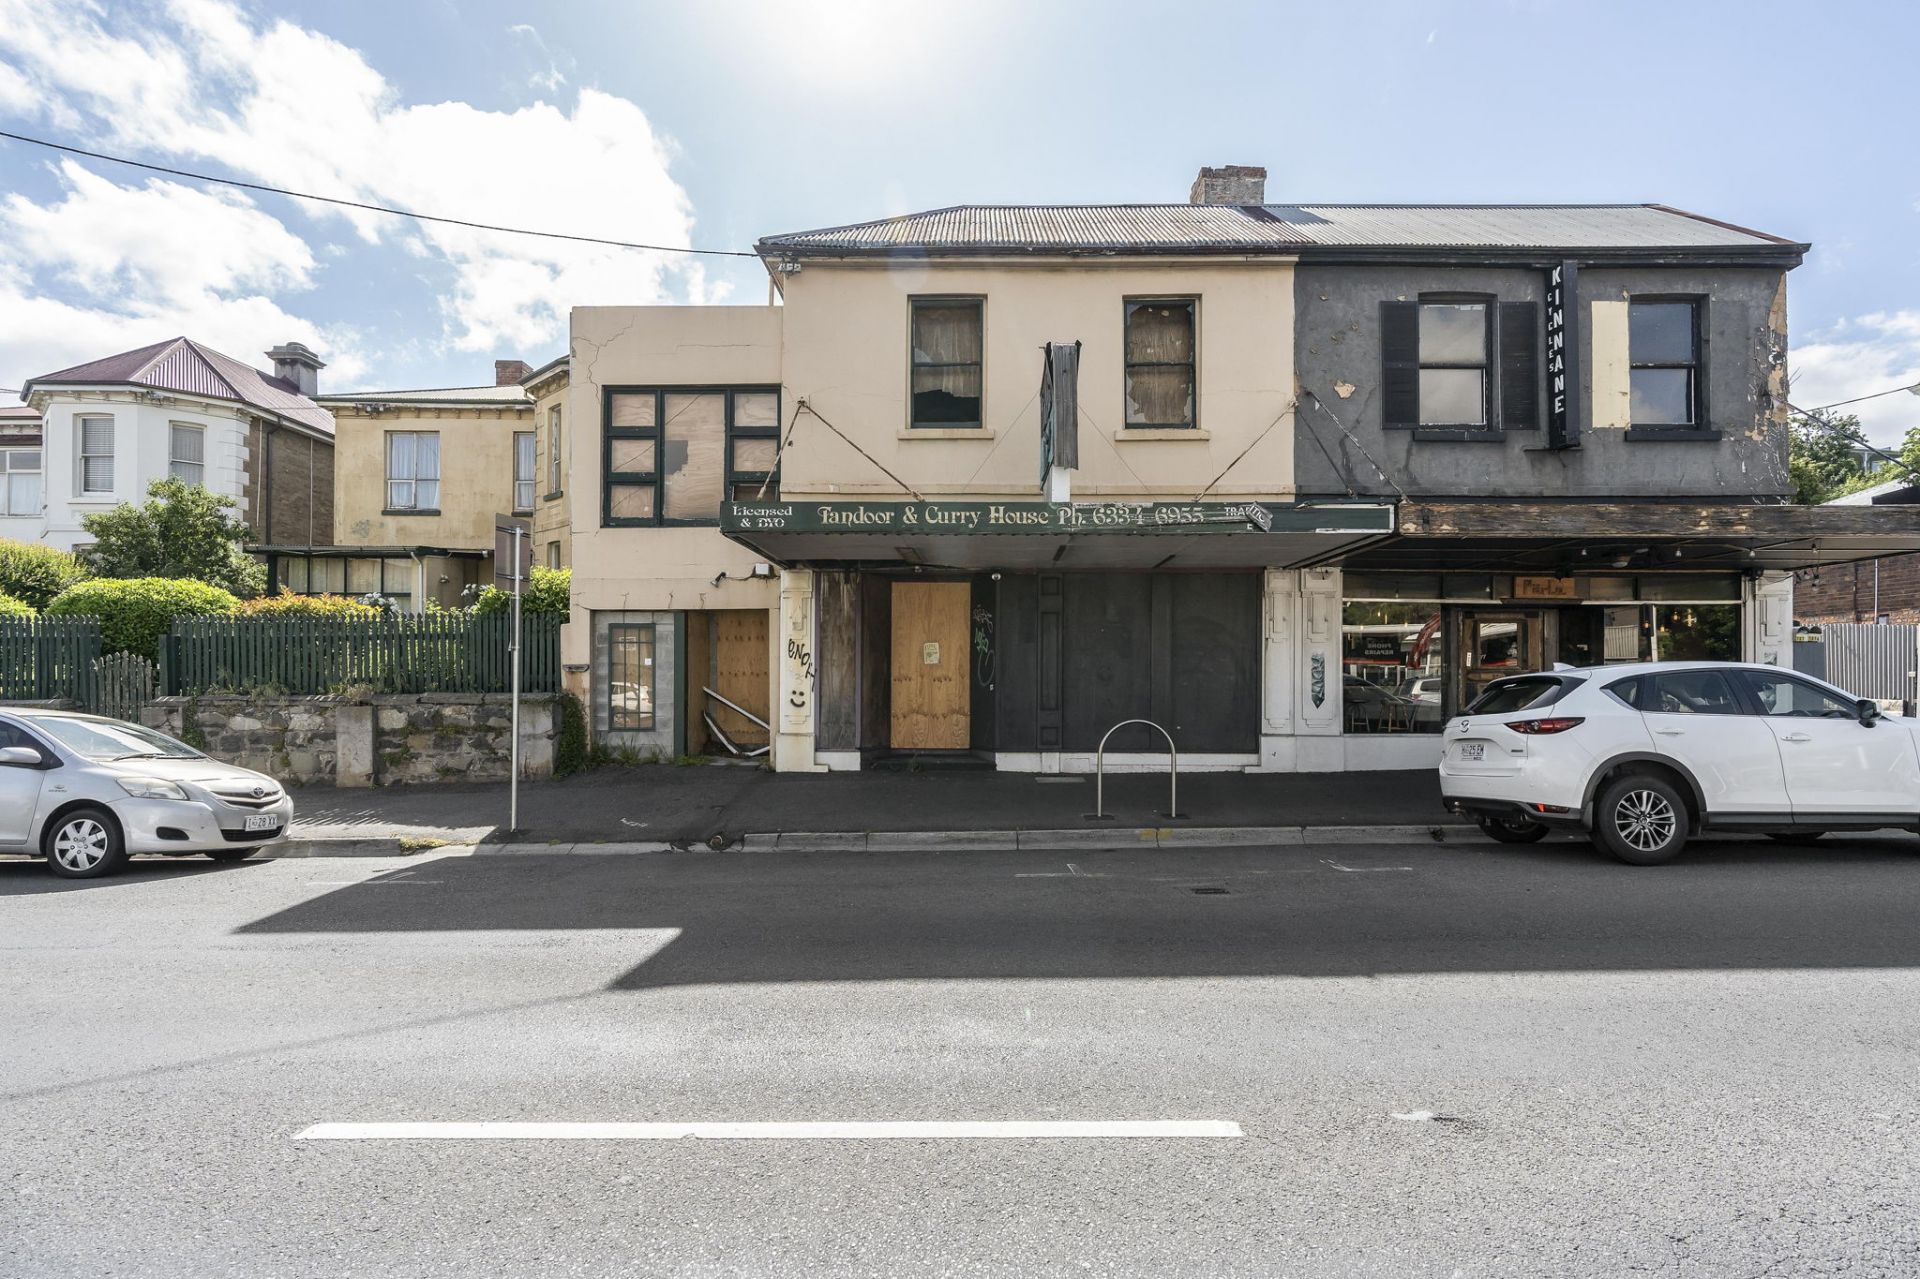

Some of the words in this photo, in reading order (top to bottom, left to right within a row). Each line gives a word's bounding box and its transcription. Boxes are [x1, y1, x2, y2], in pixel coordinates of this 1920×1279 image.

[1552, 266, 1564, 414] KINNANE
[733, 505, 792, 517] Licensed
[817, 505, 895, 528] Tandoor
[902, 505, 919, 525] &
[925, 505, 981, 529] Curry
[988, 505, 1049, 525] House
[1056, 505, 1087, 528] Ph.
[1092, 505, 1145, 526] 6334
[1154, 506, 1205, 525] 6955
[740, 517, 751, 528] &
[757, 517, 785, 528] BYO
